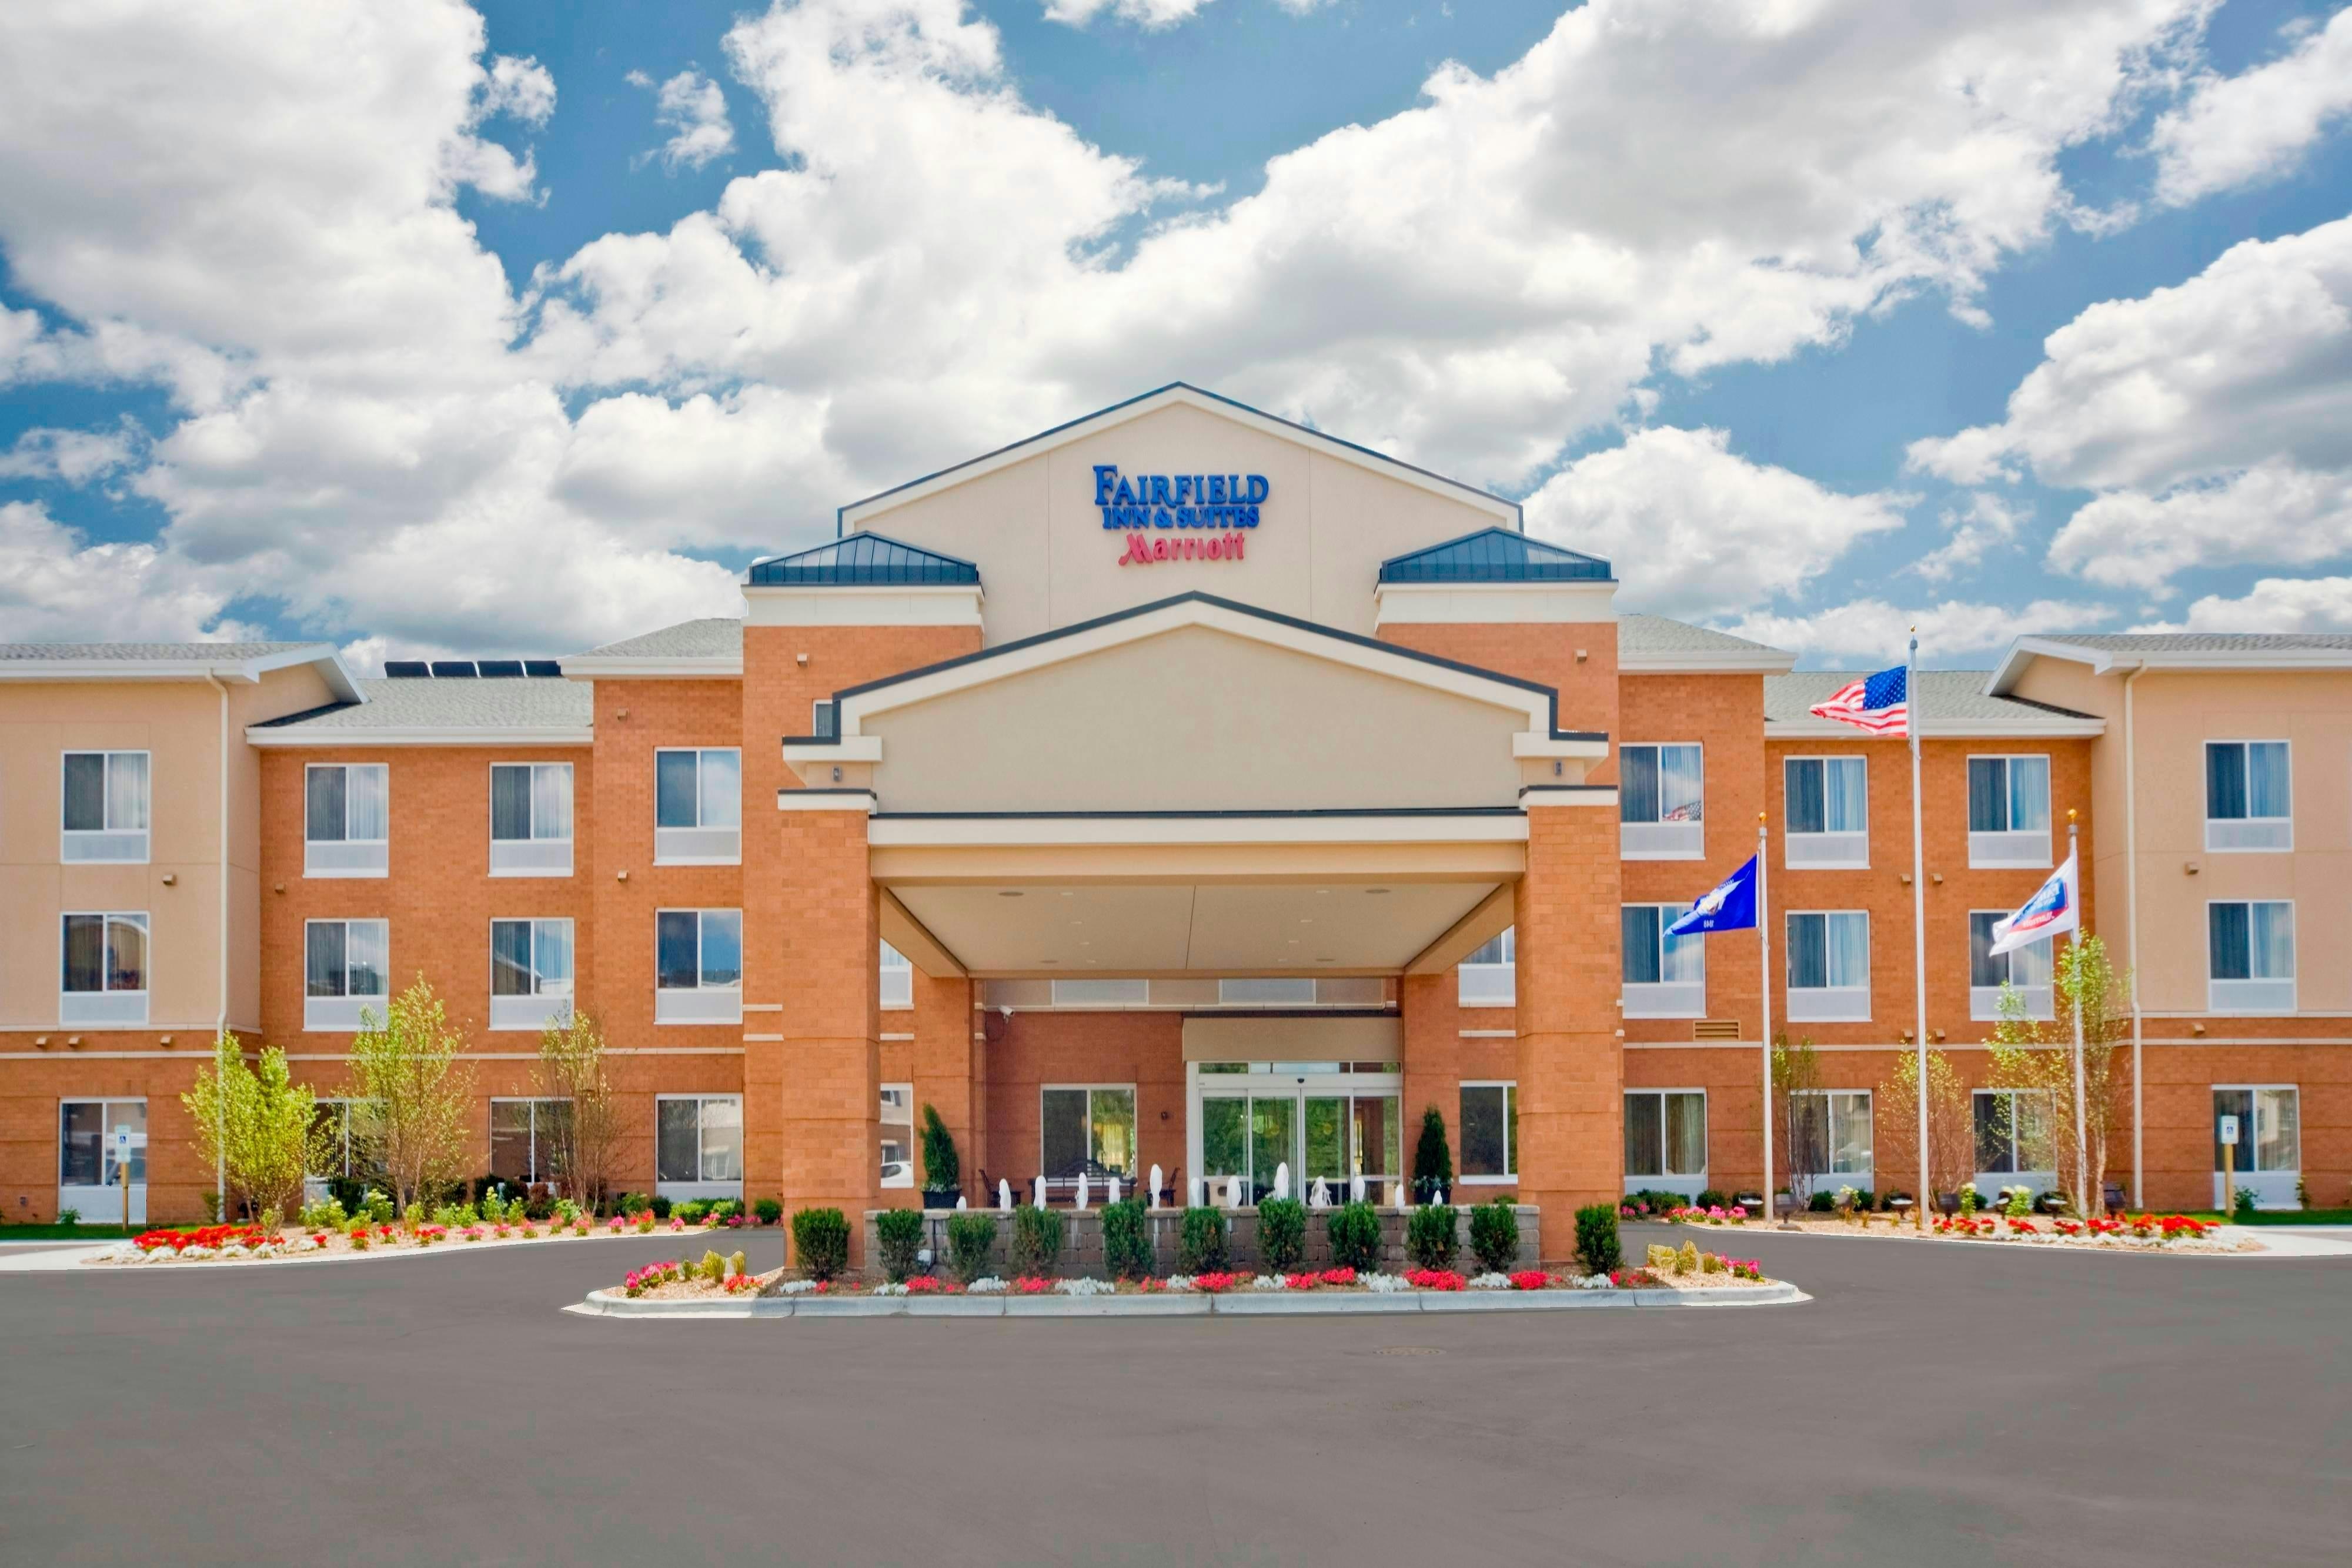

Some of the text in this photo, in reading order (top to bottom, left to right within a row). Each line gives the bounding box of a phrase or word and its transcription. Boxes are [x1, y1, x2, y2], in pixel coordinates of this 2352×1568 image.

[1093, 465, 1269, 508] FAIRFIELD
[1102, 506, 1259, 529] INN & SUITES
[1118, 531, 1245, 566] Marriott
